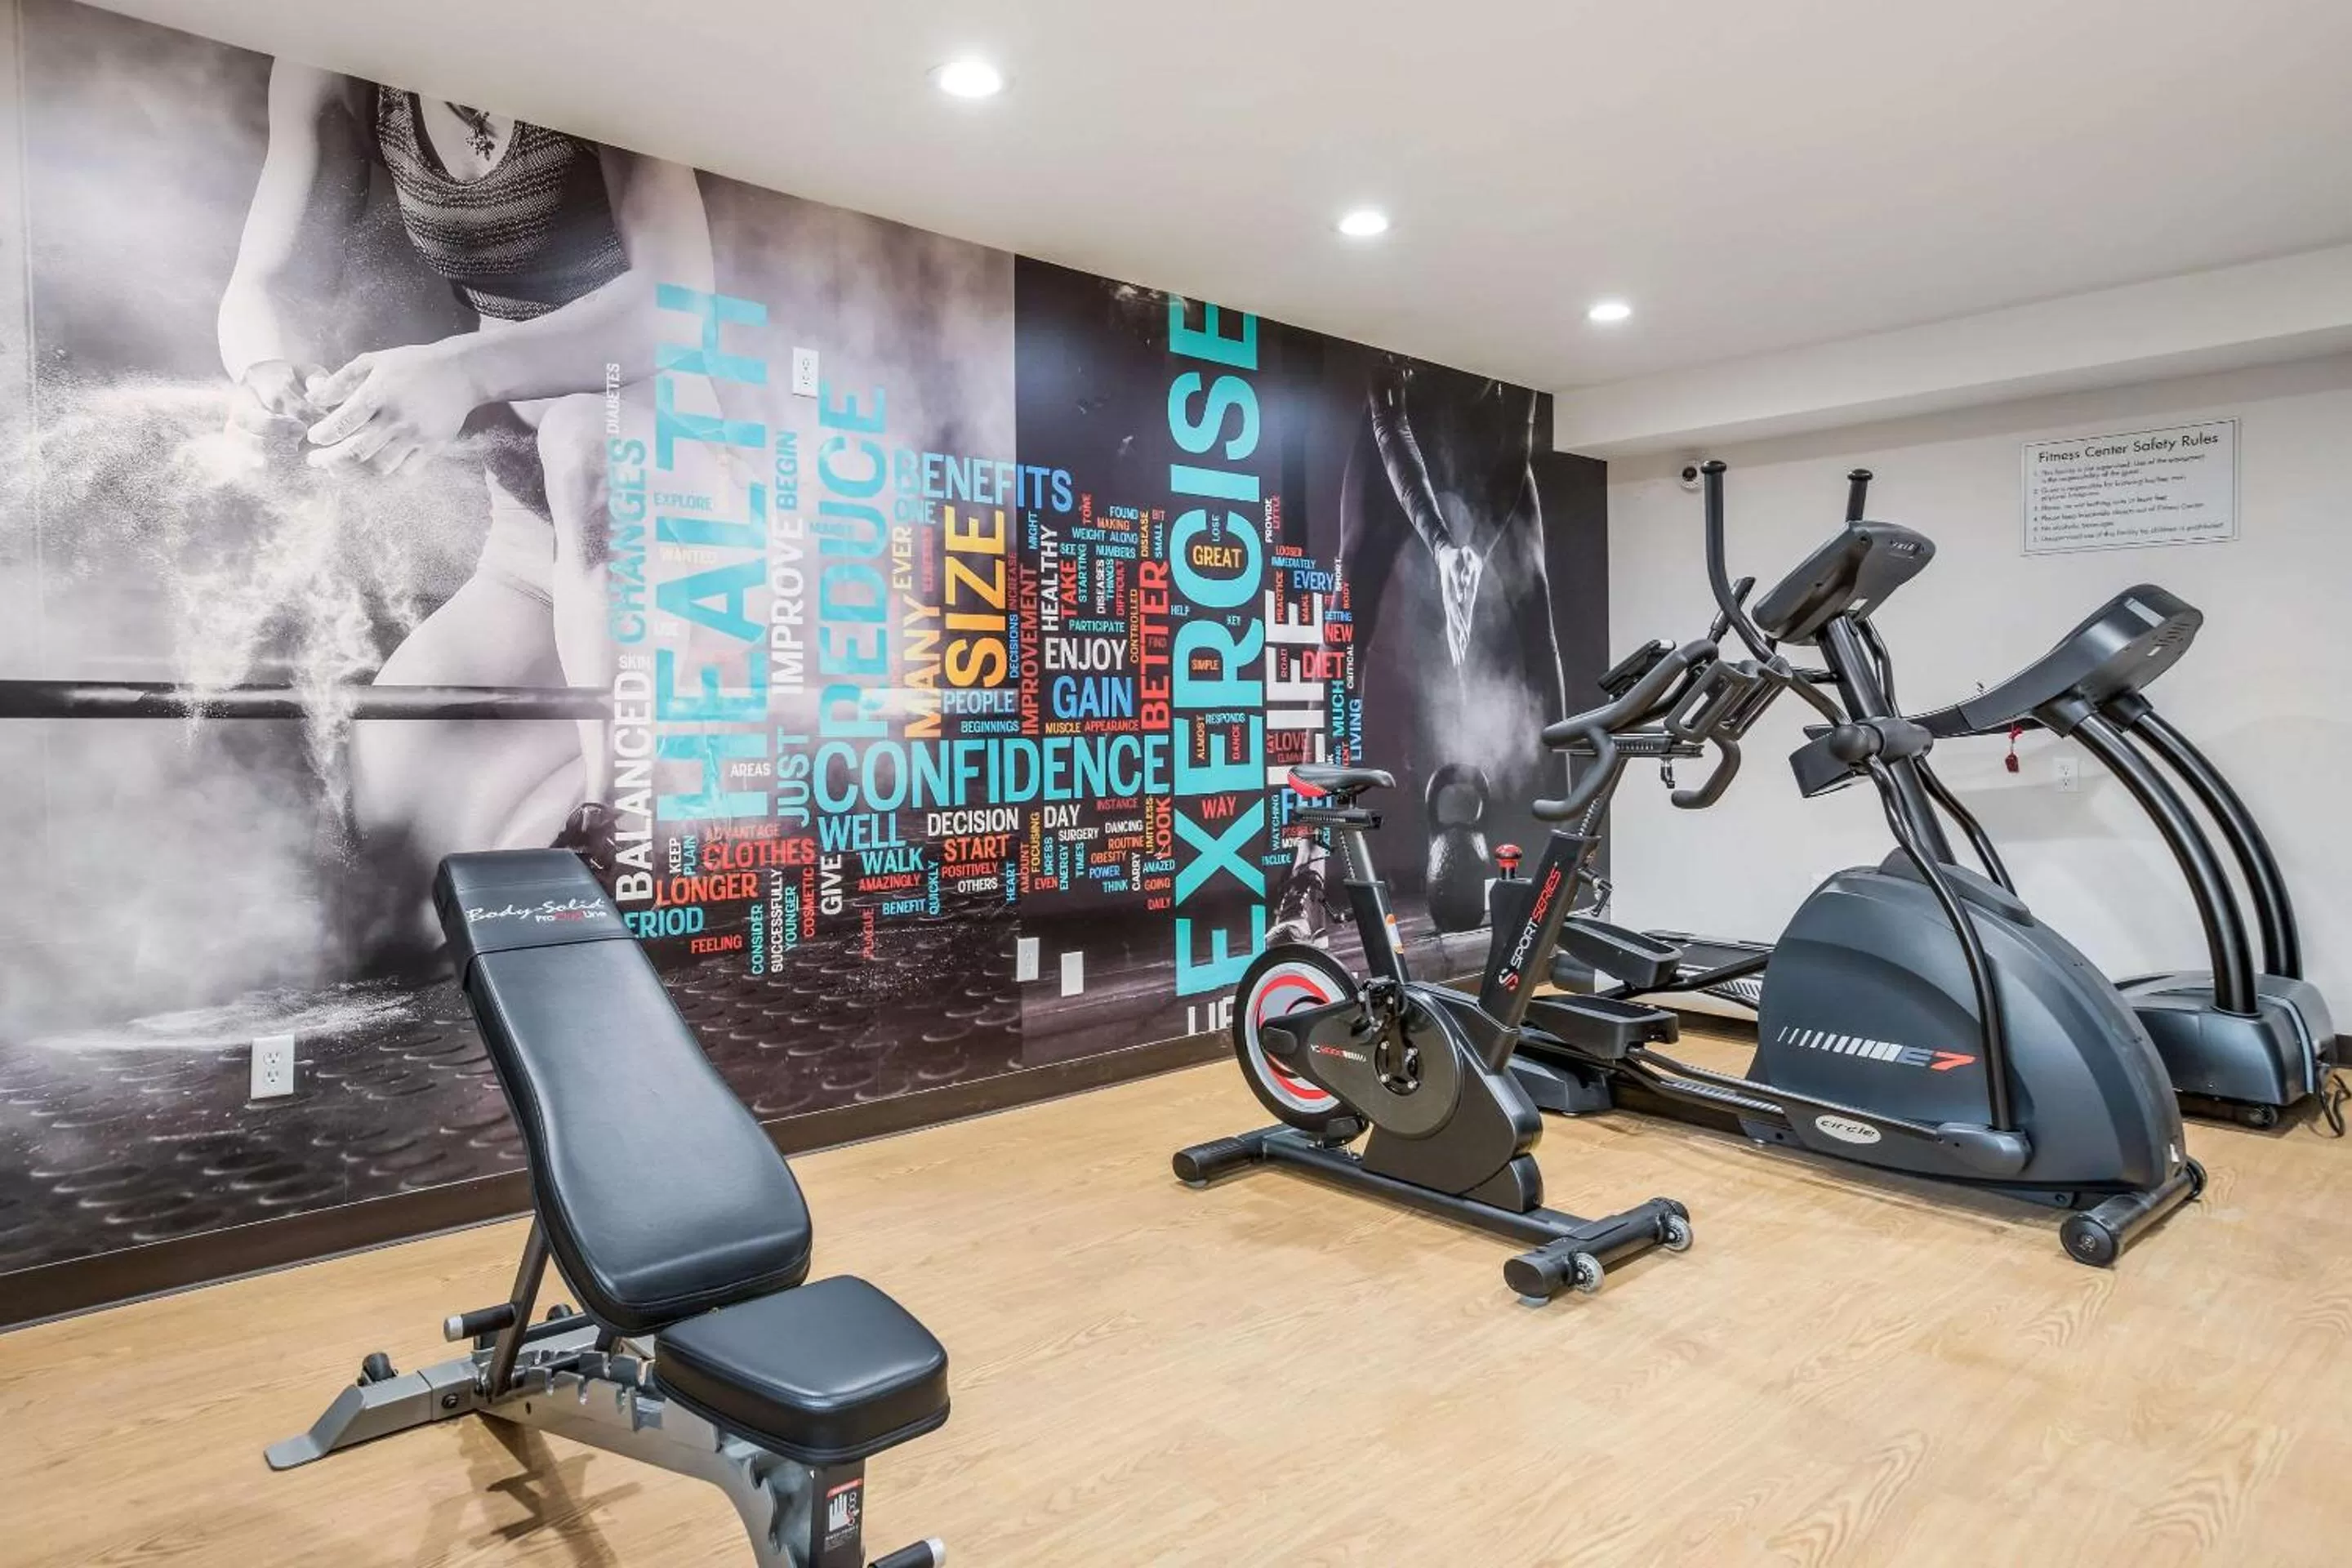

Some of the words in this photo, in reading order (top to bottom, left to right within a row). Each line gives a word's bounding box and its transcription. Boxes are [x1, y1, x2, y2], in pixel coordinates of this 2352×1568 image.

[604, 363, 621, 434] DIABETES
[2038, 450, 2080, 463] Fitness
[2085, 443, 2128, 457] Center
[2133, 437, 2176, 452] Safety
[2181, 432, 2218, 447] Rules
[774, 430, 799, 511] BEGIN
[893, 449, 1073, 513] BENEFITS
[653, 491, 712, 511] EXPLORE
[893, 497, 936, 524] ONE
[1081, 493, 1092, 525] TONE
[1109, 506, 1138, 519] FOUND
[1028, 510, 1040, 550] MIGHT
[1071, 527, 1107, 542] WEIGHT
[1097, 516, 1130, 531] MAKING
[1139, 510, 1150, 558] DISEASE
[1212, 514, 1221, 542] LOSE
[1265, 498, 1273, 543] PROVIDE
[607, 437, 647, 644] CHANGES
[656, 283, 768, 821] HEALTH
[1060, 543, 1076, 556] SEE
[1095, 545, 1136, 559] NUMBERS
[1109, 531, 1138, 545] ALONG
[1154, 522, 1164, 559] SMALL
[661, 547, 718, 564] WANTED
[817, 377, 889, 738] REDUCE
[892, 525, 912, 590] EVER
[1192, 545, 1242, 568] GREAT
[1272, 556, 1316, 569] IMMEDIATELY
[1008, 551, 1018, 611] INCREASE
[1040, 524, 1060, 631] HEALTHY
[1060, 559, 1078, 621] TAKE
[1077, 543, 1087, 603] STARTING
[1095, 559, 1106, 614] DISEASES
[1106, 558, 1114, 601] THINGS
[1116, 560, 1125, 617] DIFFICULT
[1294, 570, 1334, 591] EVERY
[771, 516, 804, 694] IMPROVE
[944, 505, 1007, 688] SIZE
[1170, 604, 1191, 616] HELP
[1276, 569, 1285, 622] PRACTICE
[1068, 618, 1125, 634] PARTICIPATE
[1129, 589, 1139, 664] CONTROLLED
[1226, 615, 1241, 626] KEY
[1324, 624, 1354, 643] NEW
[618, 653, 652, 670] SKIN
[1009, 613, 1018, 678] DECISIONS
[1020, 564, 1040, 735] IMPROVEMENT
[1045, 636, 1127, 671] ENJOY
[1139, 559, 1170, 731] BETTER
[1168, 293, 1265, 996] EXERCISE
[903, 595, 942, 738] MANY
[1191, 658, 1220, 671] SIMPLE
[1280, 648, 1288, 678] ROAD
[1302, 650, 1346, 679] DIET
[942, 689, 1016, 715] PEOPLE
[1052, 675, 1134, 719] GAIN
[1265, 589, 1325, 785] LIFE
[1332, 679, 1345, 737] MUCH
[960, 720, 1020, 734] BEGINNINGS
[1045, 721, 1081, 734] MUSCLE
[1084, 719, 1140, 733] APPEARANCE
[1275, 732, 1307, 751] LOVE
[1349, 698, 1363, 761] LIVING
[614, 671, 653, 902] BALANCED
[730, 762, 772, 777] AREAS
[777, 728, 810, 827] JUST
[813, 734, 1170, 814] CONFIDENCE
[1044, 804, 1081, 829] DAY
[1096, 798, 1138, 811] INSTANCE
[1201, 796, 1236, 820] WAY
[706, 823, 781, 841] ADVANTAGE
[817, 811, 907, 853] WELL
[926, 807, 1020, 837] DECISION
[1058, 827, 1099, 842] SURGERY
[1104, 820, 1143, 834] DANCING
[1144, 795, 1154, 854] LIMITLESS
[1156, 797, 1171, 858] LOOK
[1272, 794, 1280, 850] WATCHING
[669, 838, 681, 874] KEEP
[683, 835, 696, 876] PLAIN
[702, 837, 815, 871] CLOTHES
[944, 834, 1011, 862] START
[1031, 812, 1040, 873] FOCUSING
[1045, 836, 1054, 876] DRESS
[1076, 841, 1085, 878] TIMES
[1090, 851, 1127, 864] OBESITY
[1107, 835, 1144, 850] ROUTINE
[1262, 853, 1292, 866] INCLUDE
[861, 848, 924, 876] WALK
[942, 862, 999, 879] POSITIVELY
[1019, 842, 1029, 893] AMOUNT
[1059, 844, 1069, 890] ENERGY
[1089, 866, 1120, 879] POWER
[1131, 852, 1141, 891] CARRY
[1142, 858, 1175, 873] AMAZED
[656, 873, 759, 906] LONGER
[820, 854, 843, 915] GIVE
[858, 873, 921, 892] AMAZINGLY
[929, 860, 940, 916] QUICKLY
[957, 878, 999, 893] OTHERS
[1006, 861, 1016, 903] HEART
[1034, 876, 1058, 891] EVEN
[1102, 878, 1129, 892] THINK
[1143, 878, 1171, 891] GOING
[784, 885, 797, 951] YOUNGER
[803, 867, 816, 939] COSMETIC
[882, 898, 926, 915] BENEFIT
[1147, 898, 1171, 911] DAILY
[623, 906, 704, 938] ERIOD
[770, 868, 783, 973] SUCCESSFULLY
[863, 907, 875, 960] PLAGUE
[691, 934, 743, 954] FEELING
[751, 904, 764, 975] CONSIDER
[1820, 1120, 1876, 1138] circle
